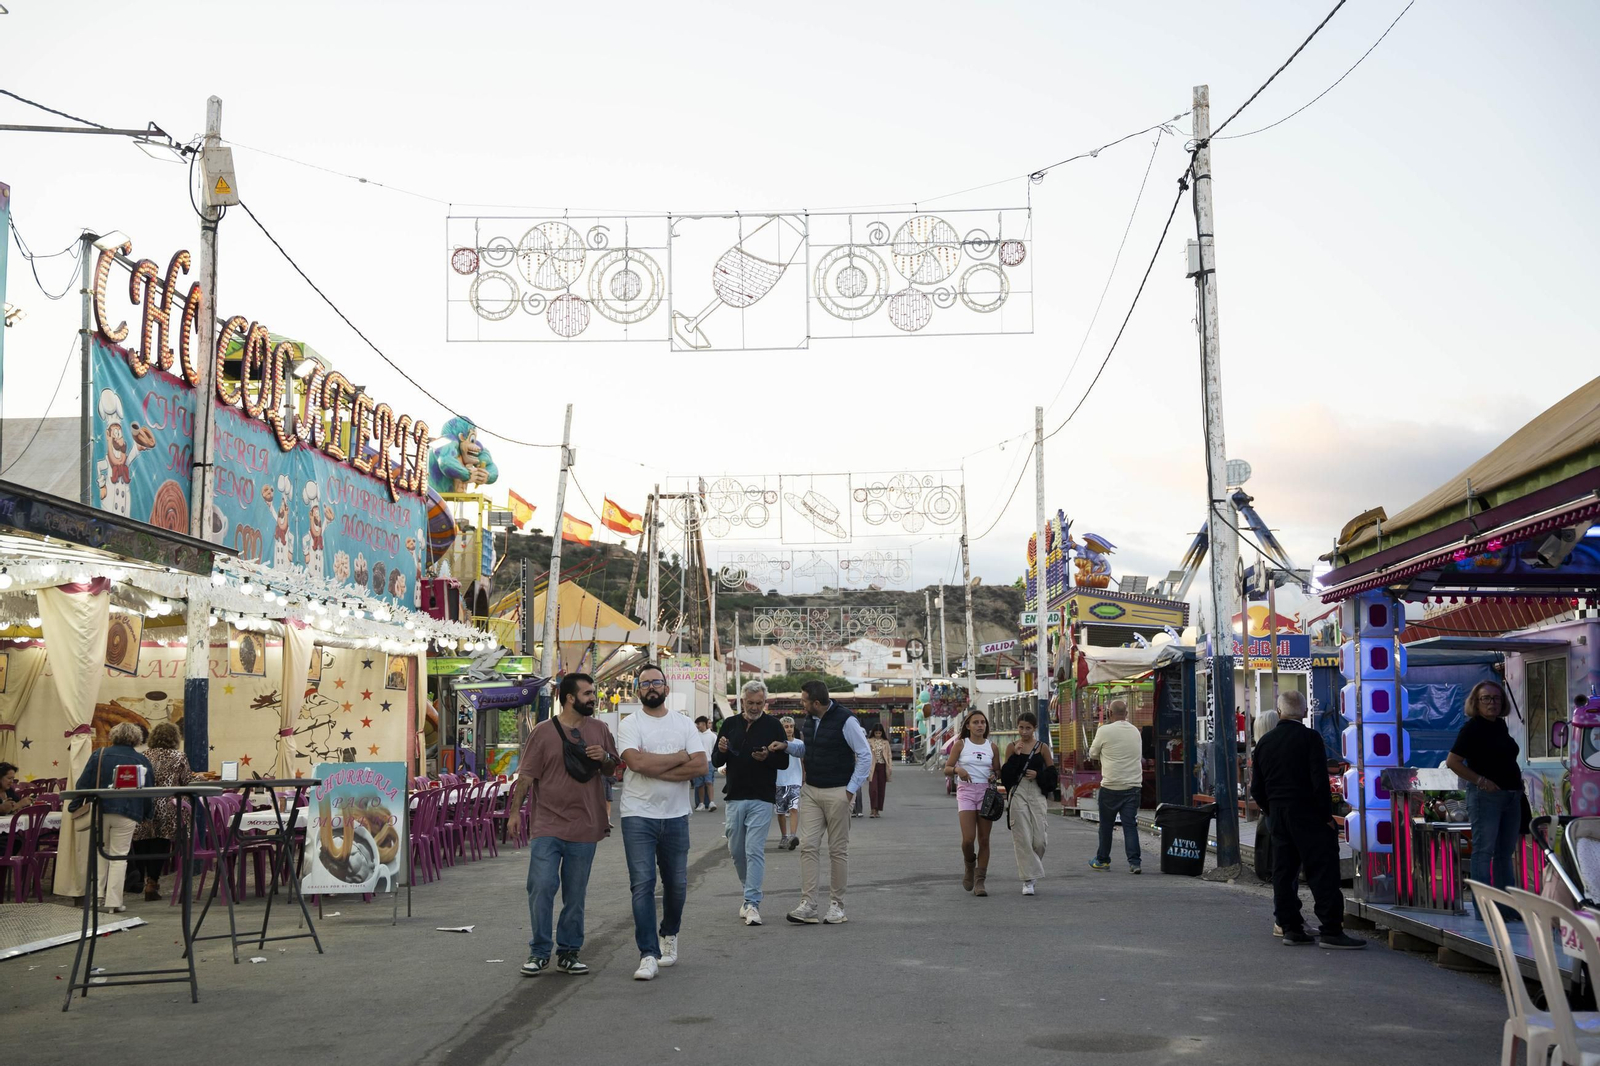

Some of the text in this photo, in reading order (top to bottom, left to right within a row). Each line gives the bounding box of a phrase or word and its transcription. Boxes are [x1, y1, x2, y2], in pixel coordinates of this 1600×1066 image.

[143, 391, 269, 475] CHURERIA
[167, 443, 254, 510] MENO
[327, 475, 411, 529] CHURRERIA
[341, 513, 400, 559] MORENO
[1025, 613, 1060, 624] ENAD
[984, 641, 1015, 653] SALIDA
[315, 769, 399, 802] CHURRERIA
[332, 796, 382, 809] PACO
[1167, 846, 1200, 859] ALBOX
